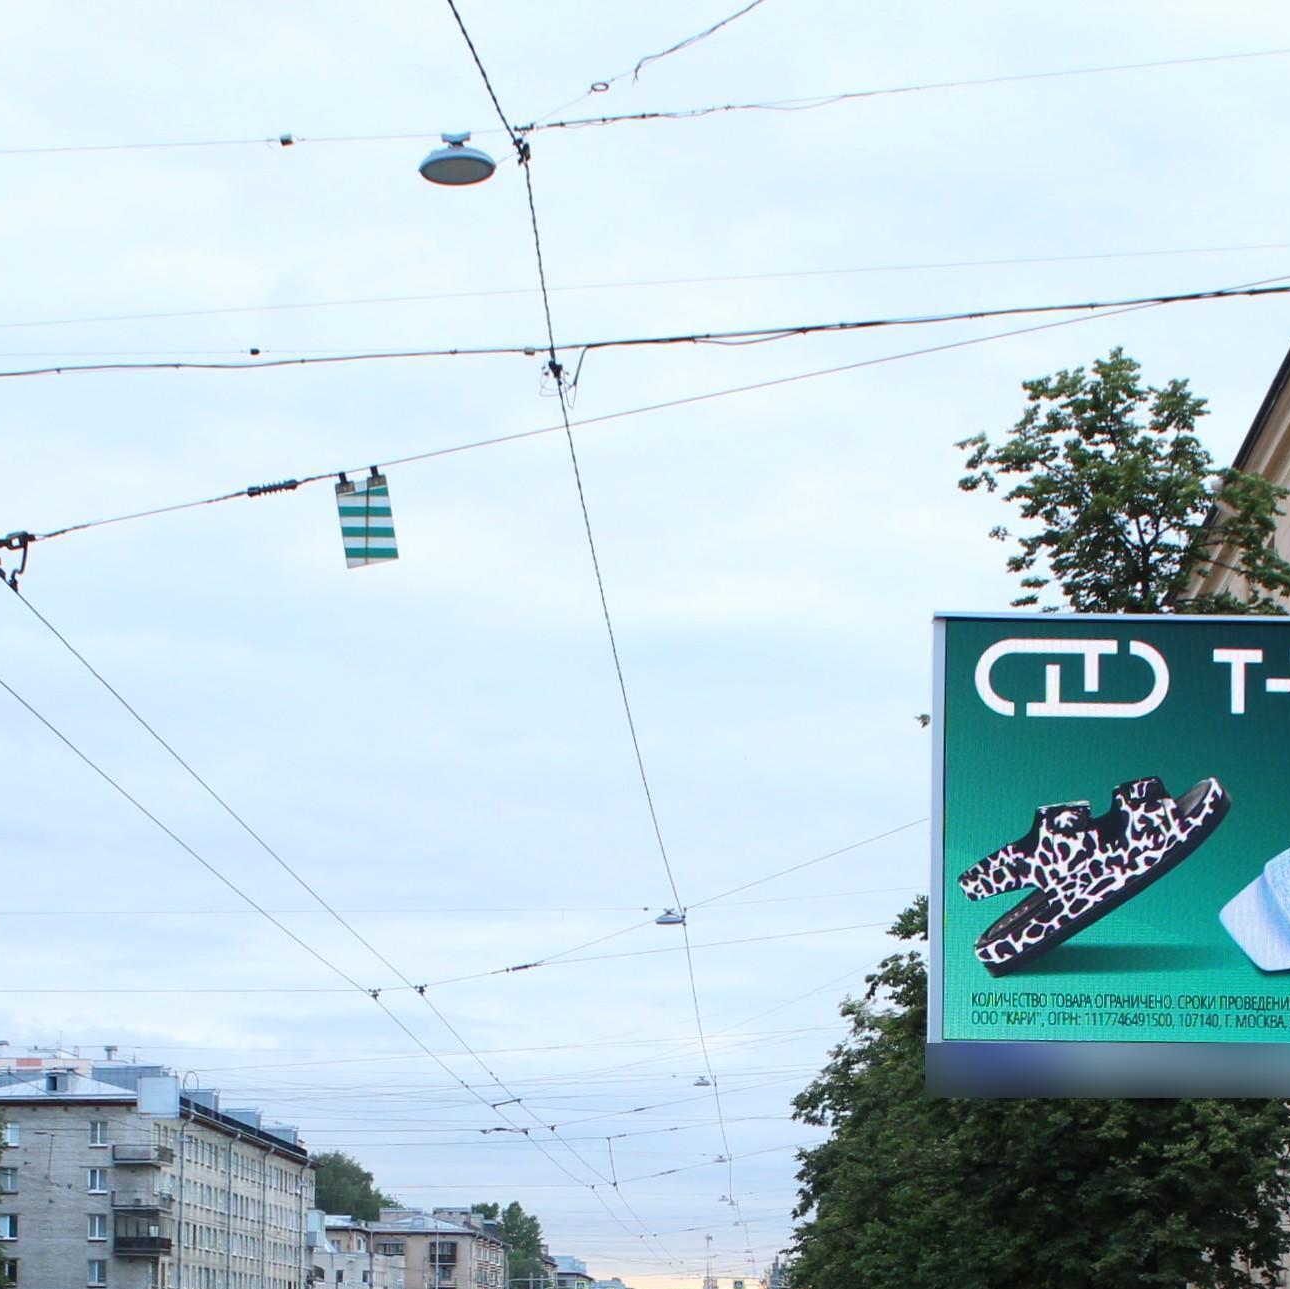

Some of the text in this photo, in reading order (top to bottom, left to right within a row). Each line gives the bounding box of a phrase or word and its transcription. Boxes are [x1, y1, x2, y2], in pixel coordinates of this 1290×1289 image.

[971, 992, 1048, 1008] КОЛИЧЕСТВО
[1051, 993, 1092, 1008] ТОВАРА
[1094, 993, 1175, 1010] ОГРАНИЧЕНО.
[1177, 994, 1216, 1010] СРОКИ
[971, 1010, 999, 1025] ООО
[1002, 1010, 1045, 1028] "КАРИ",
[1048, 1011, 1082, 1026] ОГРН:
[1179, 1013, 1223, 1030] 107140,
[1235, 1014, 1288, 1031] МОСКВА,
